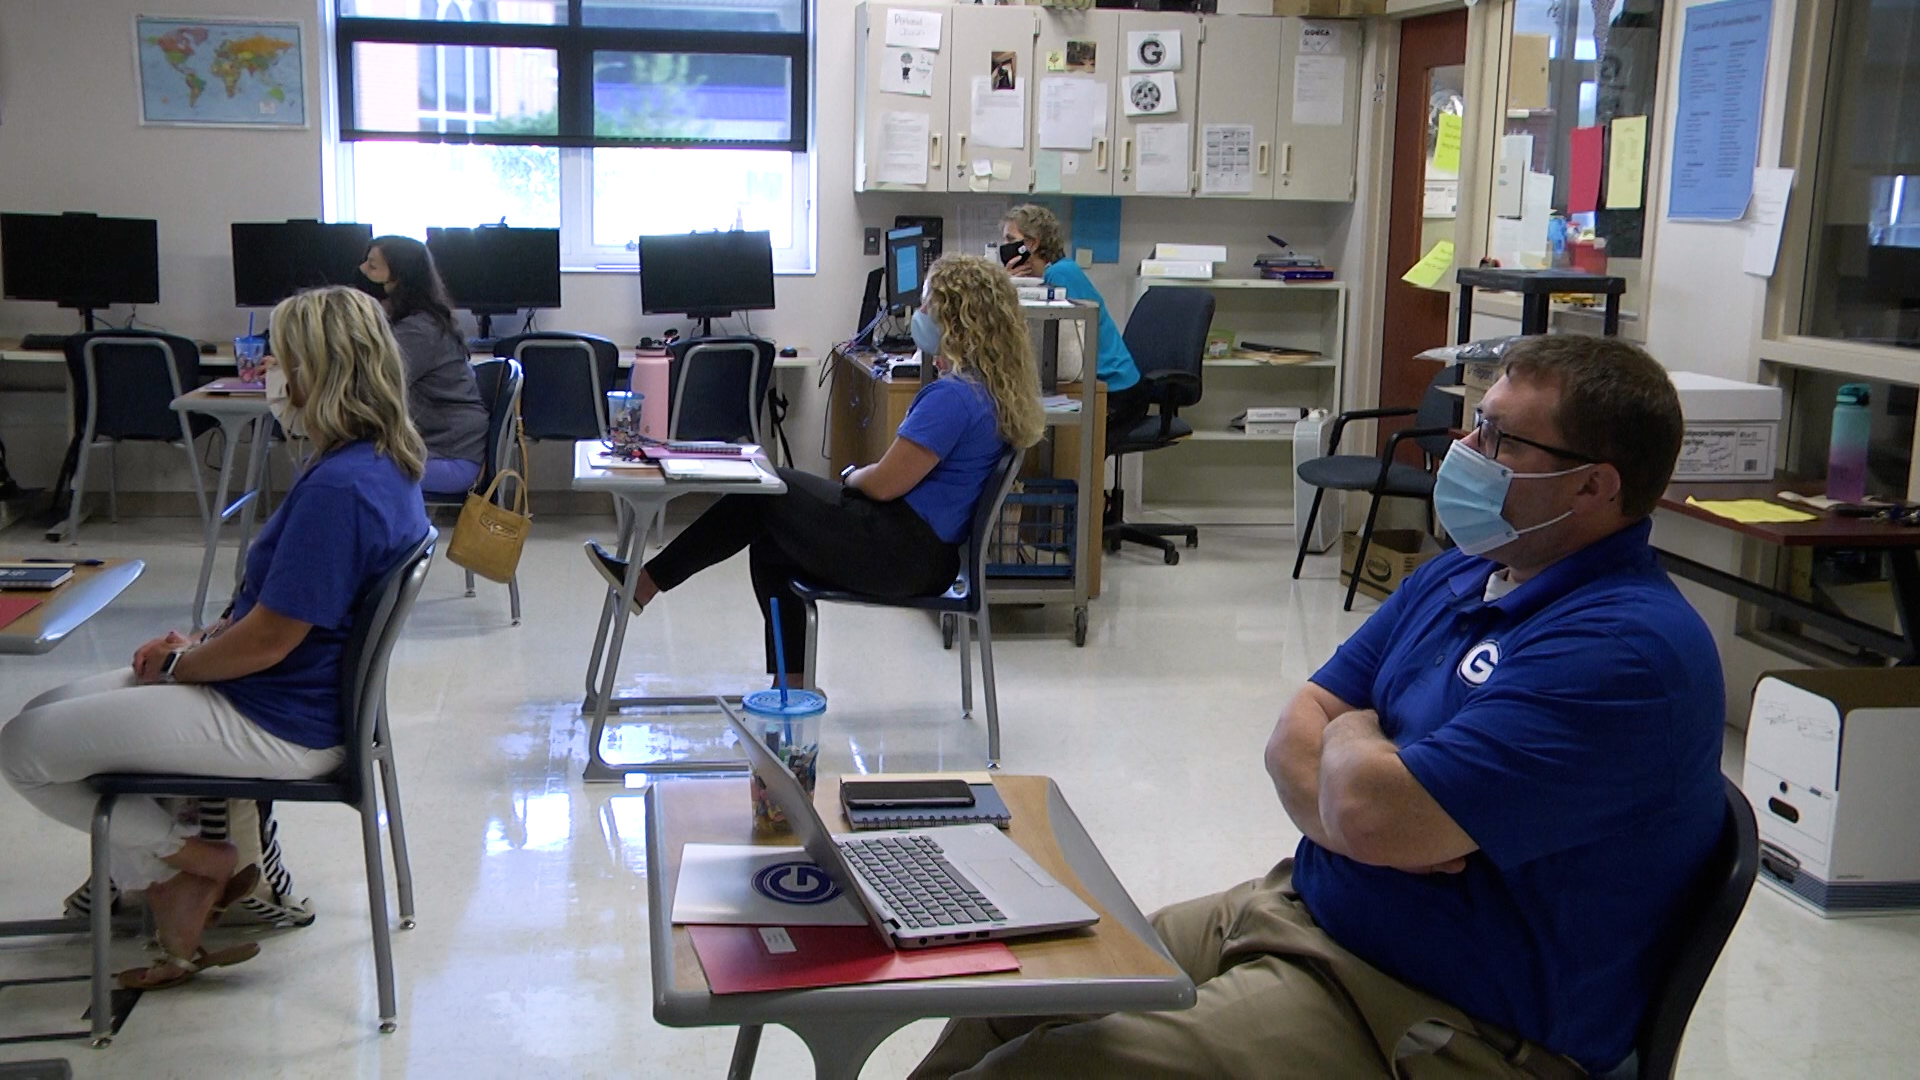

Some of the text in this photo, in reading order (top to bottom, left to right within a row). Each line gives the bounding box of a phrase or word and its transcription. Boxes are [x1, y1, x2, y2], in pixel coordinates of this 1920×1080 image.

[1141, 41, 1162, 65] G
[1461, 642, 1499, 684] G
[769, 867, 832, 900] G
